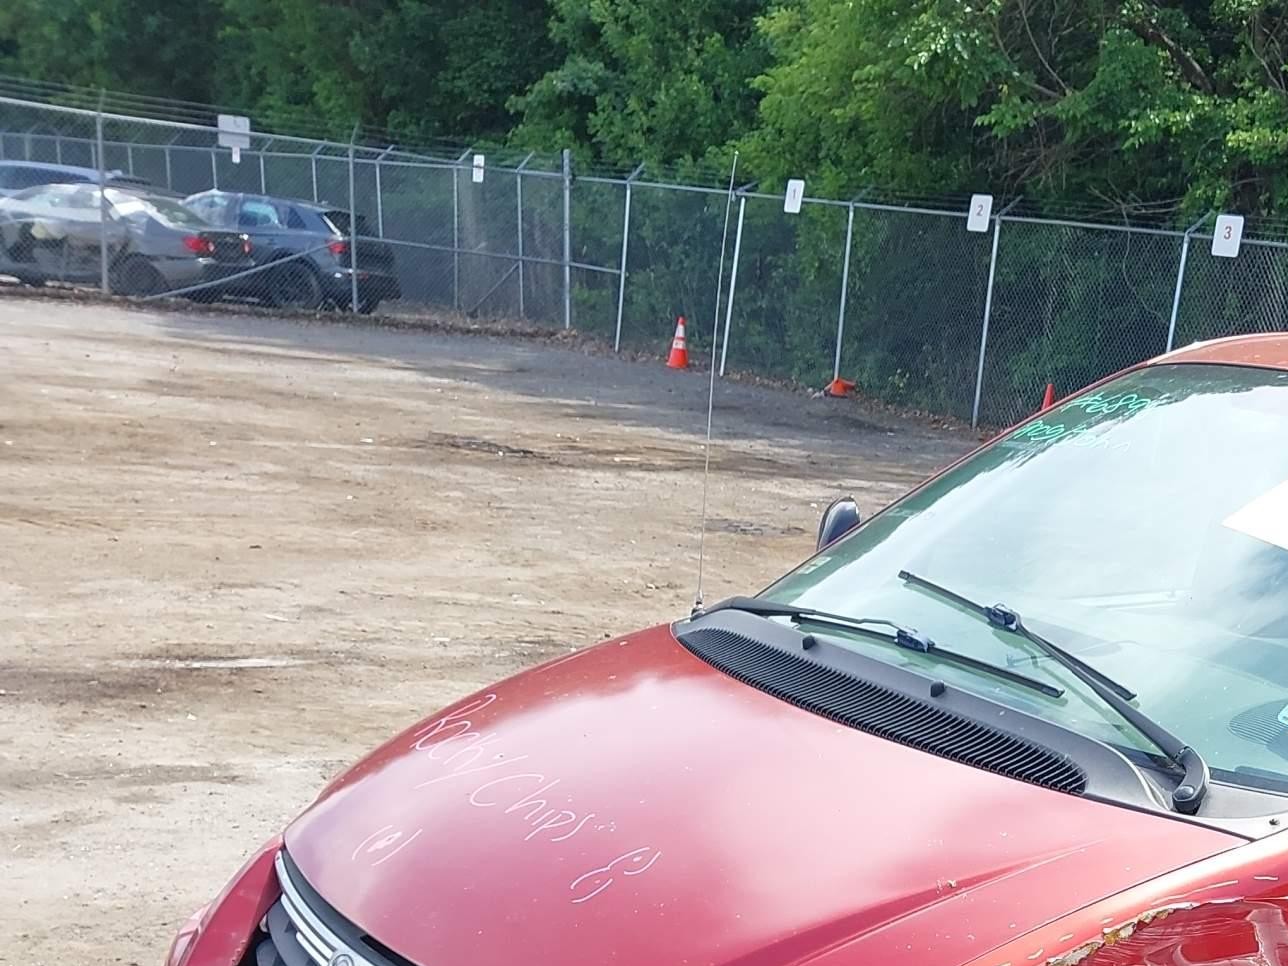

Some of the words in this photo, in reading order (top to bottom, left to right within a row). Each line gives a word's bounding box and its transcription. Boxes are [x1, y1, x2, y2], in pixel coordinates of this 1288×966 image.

[976, 204, 984, 217] 2
[1223, 225, 1233, 240] 3
[468, 773, 596, 842] Chips
